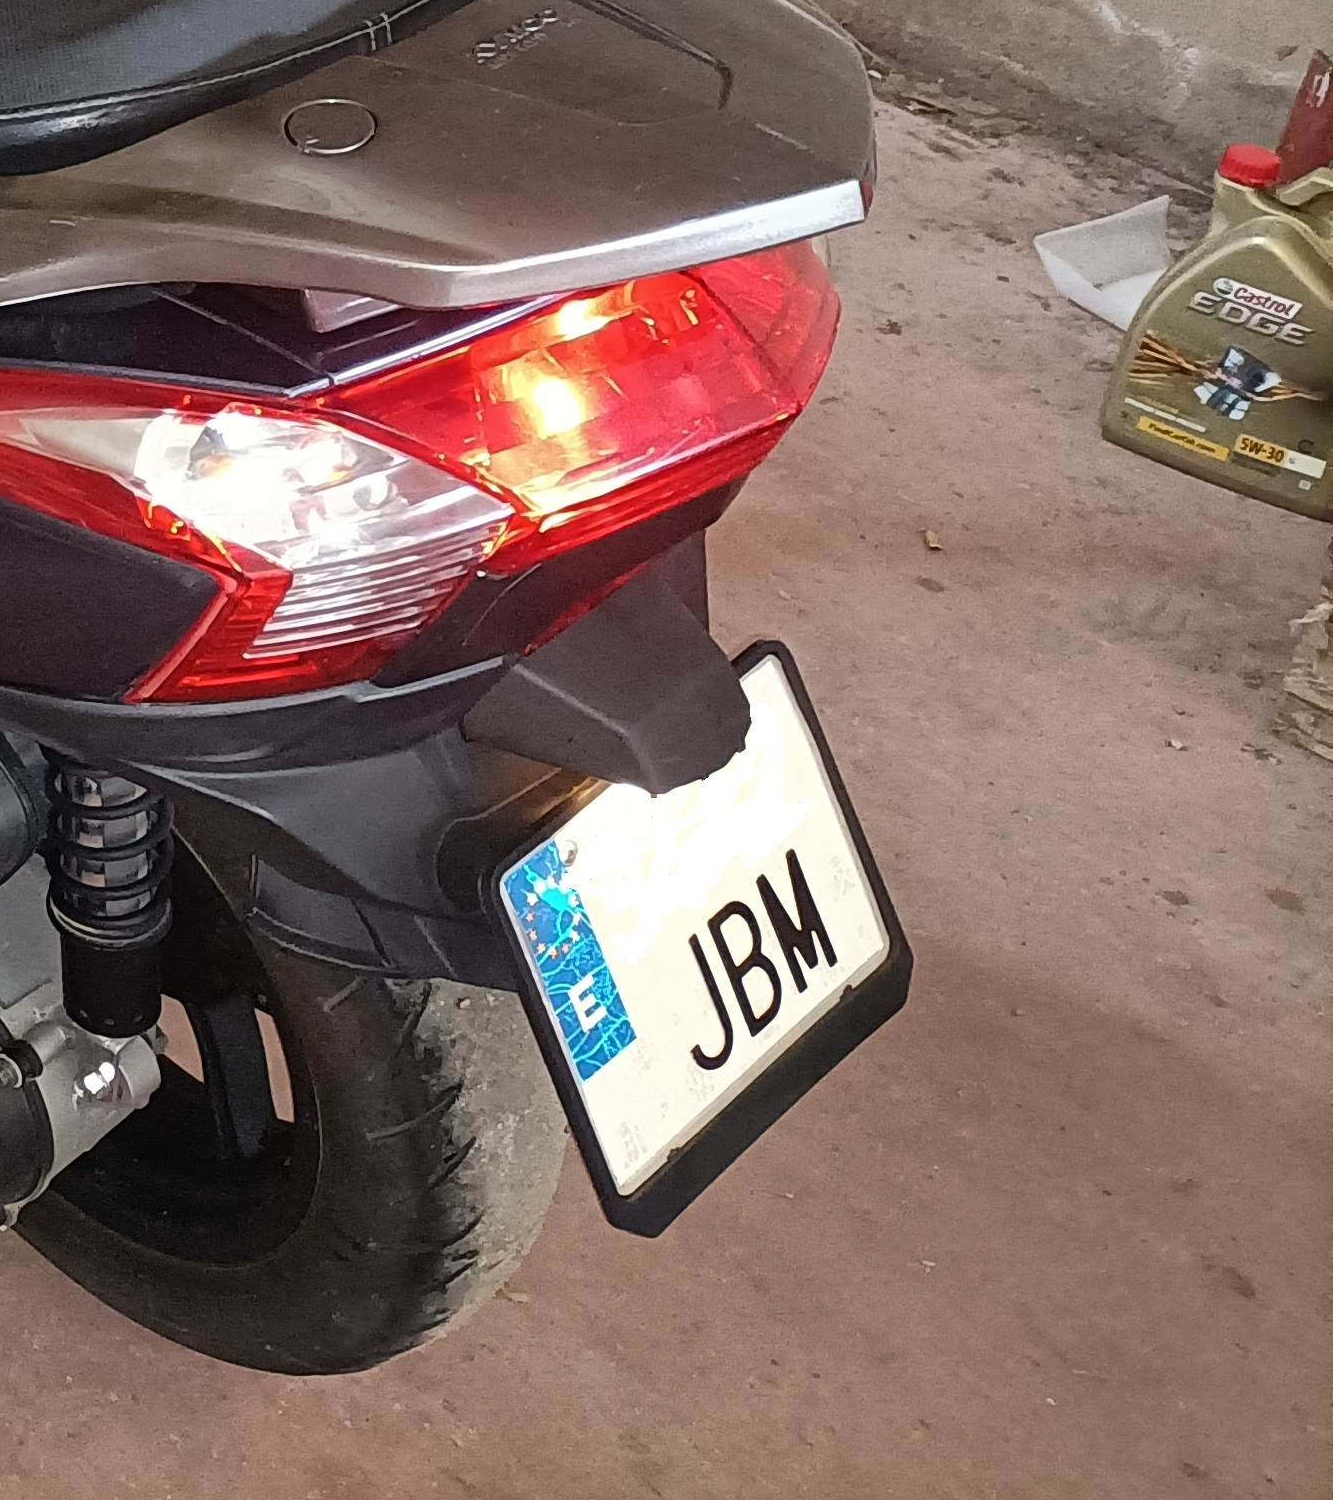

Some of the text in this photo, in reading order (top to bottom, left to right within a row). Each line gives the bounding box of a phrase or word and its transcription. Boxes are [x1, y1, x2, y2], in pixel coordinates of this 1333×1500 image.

[1189, 291, 1314, 345] EDGE
[1234, 287, 1295, 316] Castrol
[1239, 437, 1285, 463] 5W-30
[689, 849, 838, 1070] JBM
[569, 975, 608, 1032] E
